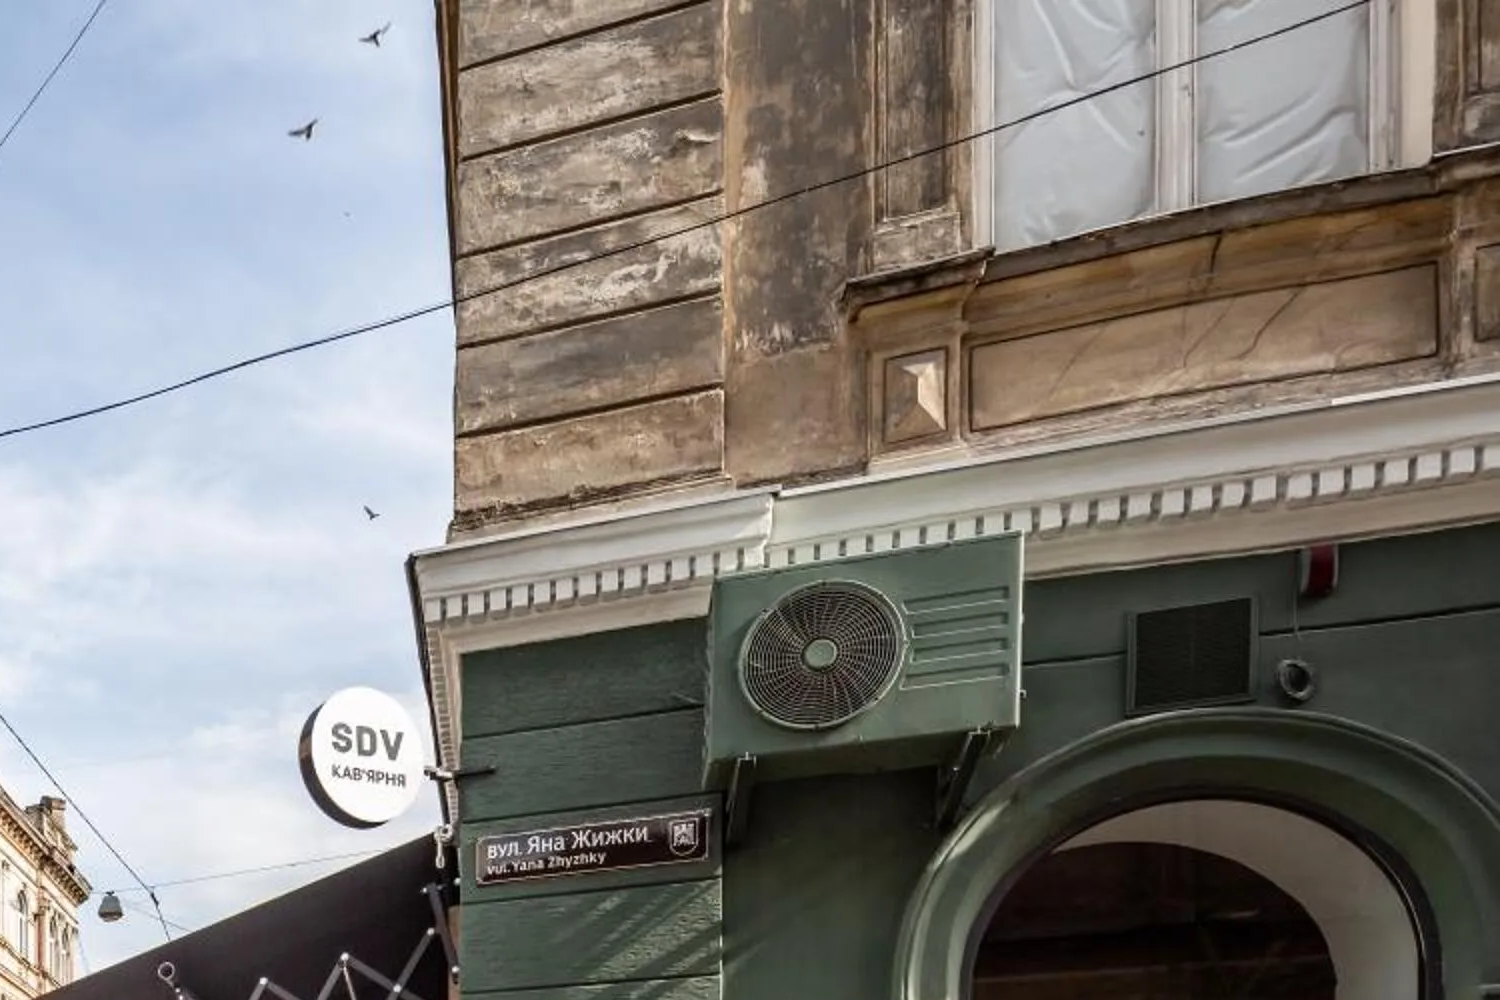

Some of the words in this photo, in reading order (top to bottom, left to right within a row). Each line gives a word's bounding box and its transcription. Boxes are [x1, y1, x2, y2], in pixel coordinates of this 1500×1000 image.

[332, 721, 405, 762] SDV
[487, 842, 523, 860] вул.
[527, 836, 566, 855] Яна
[571, 826, 649, 850] Жижки
[487, 863, 510, 876] vul.
[512, 858, 546, 873] Yana
[547, 851, 607, 869] Zhyzhky
